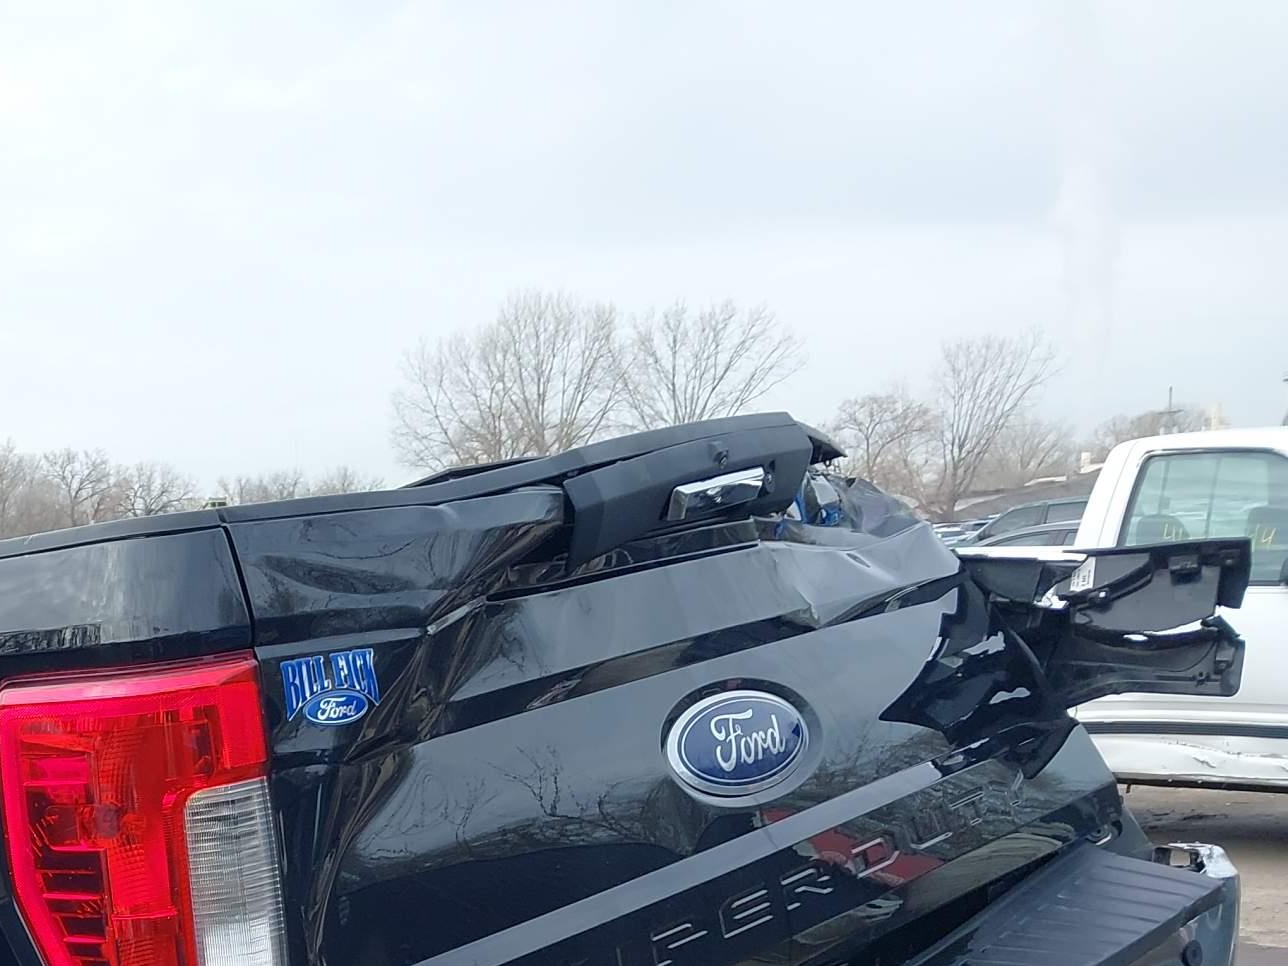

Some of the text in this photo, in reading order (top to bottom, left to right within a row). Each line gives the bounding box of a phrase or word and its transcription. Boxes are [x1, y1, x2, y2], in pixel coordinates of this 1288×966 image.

[279, 655, 333, 722] BILL
[316, 695, 358, 721] Ford
[710, 708, 786, 773] Ford
